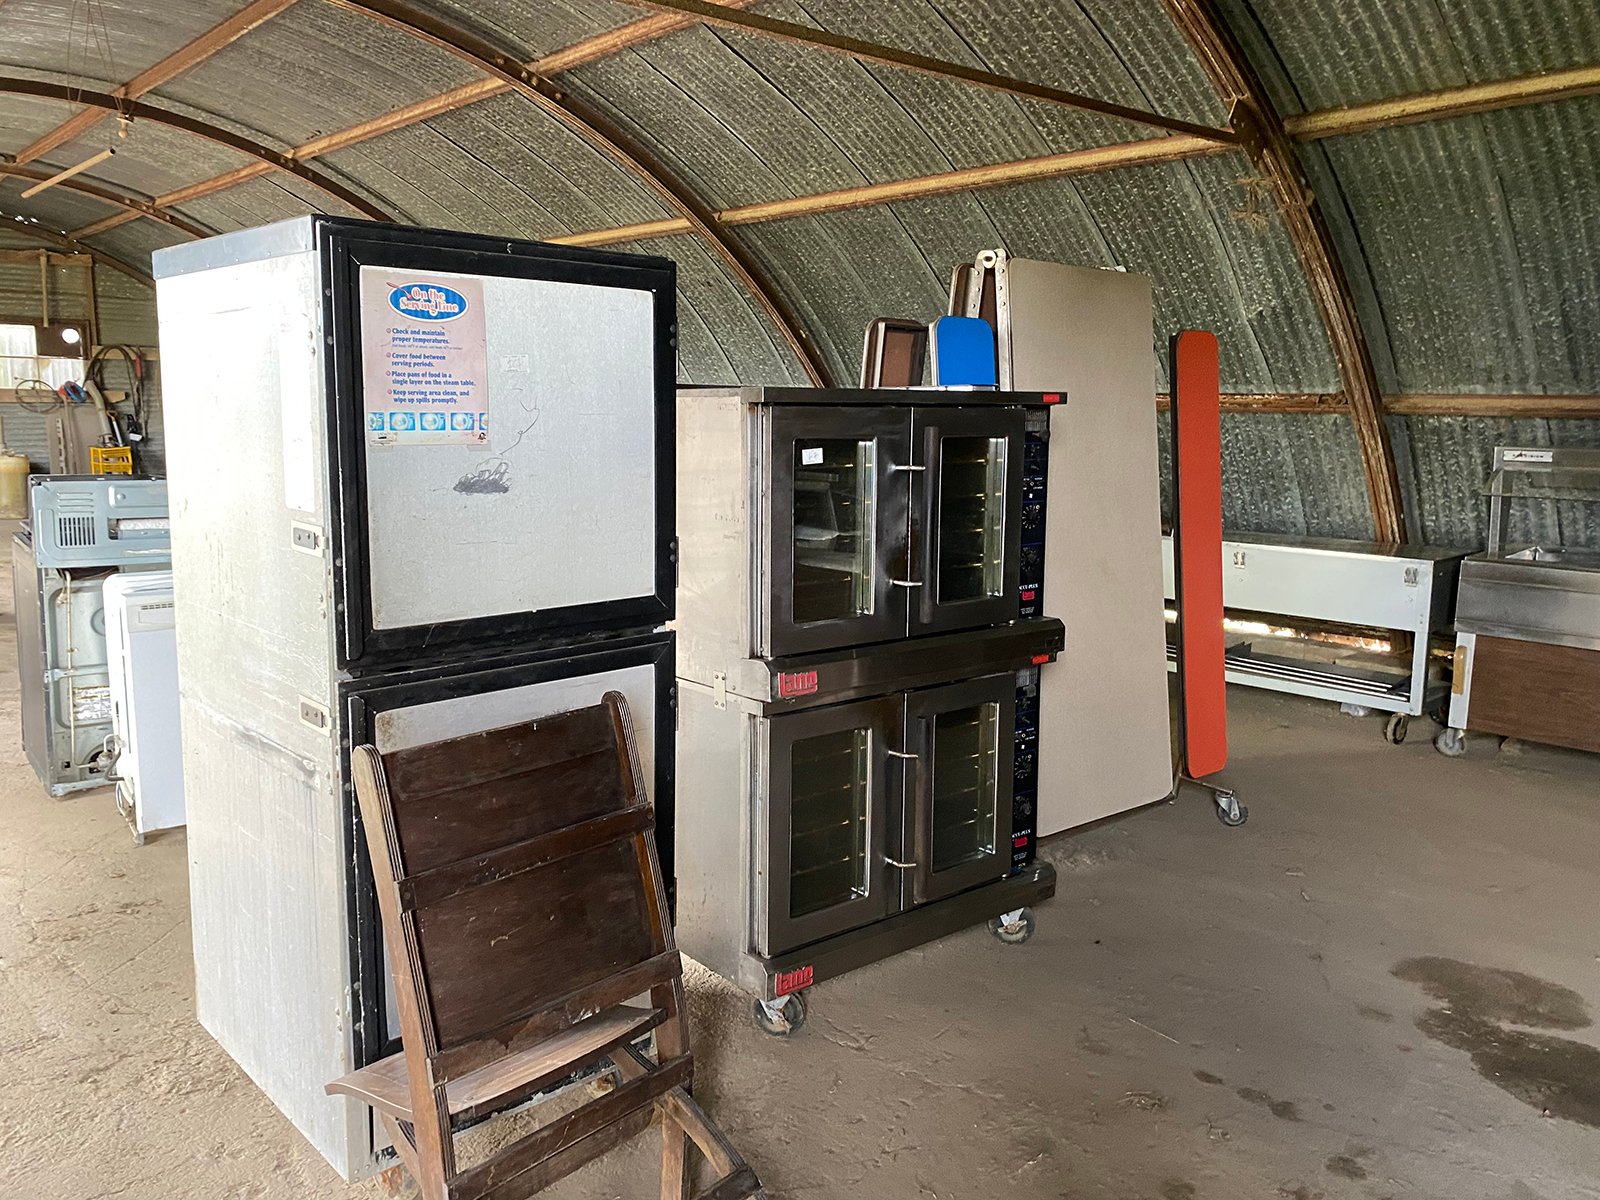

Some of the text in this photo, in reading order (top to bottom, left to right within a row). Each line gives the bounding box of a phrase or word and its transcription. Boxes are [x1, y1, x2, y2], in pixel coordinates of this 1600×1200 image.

[411, 287, 445, 301] On the
[400, 297, 459, 316] Serving Line
[409, 352, 422, 360] food
[392, 360, 412, 368] serving
[392, 378, 408, 386] single
[409, 378, 423, 386] layer
[407, 389, 428, 397] serving
[442, 389, 458, 397] clean,
[394, 396, 407, 404] wipe
[416, 396, 430, 404] spills
